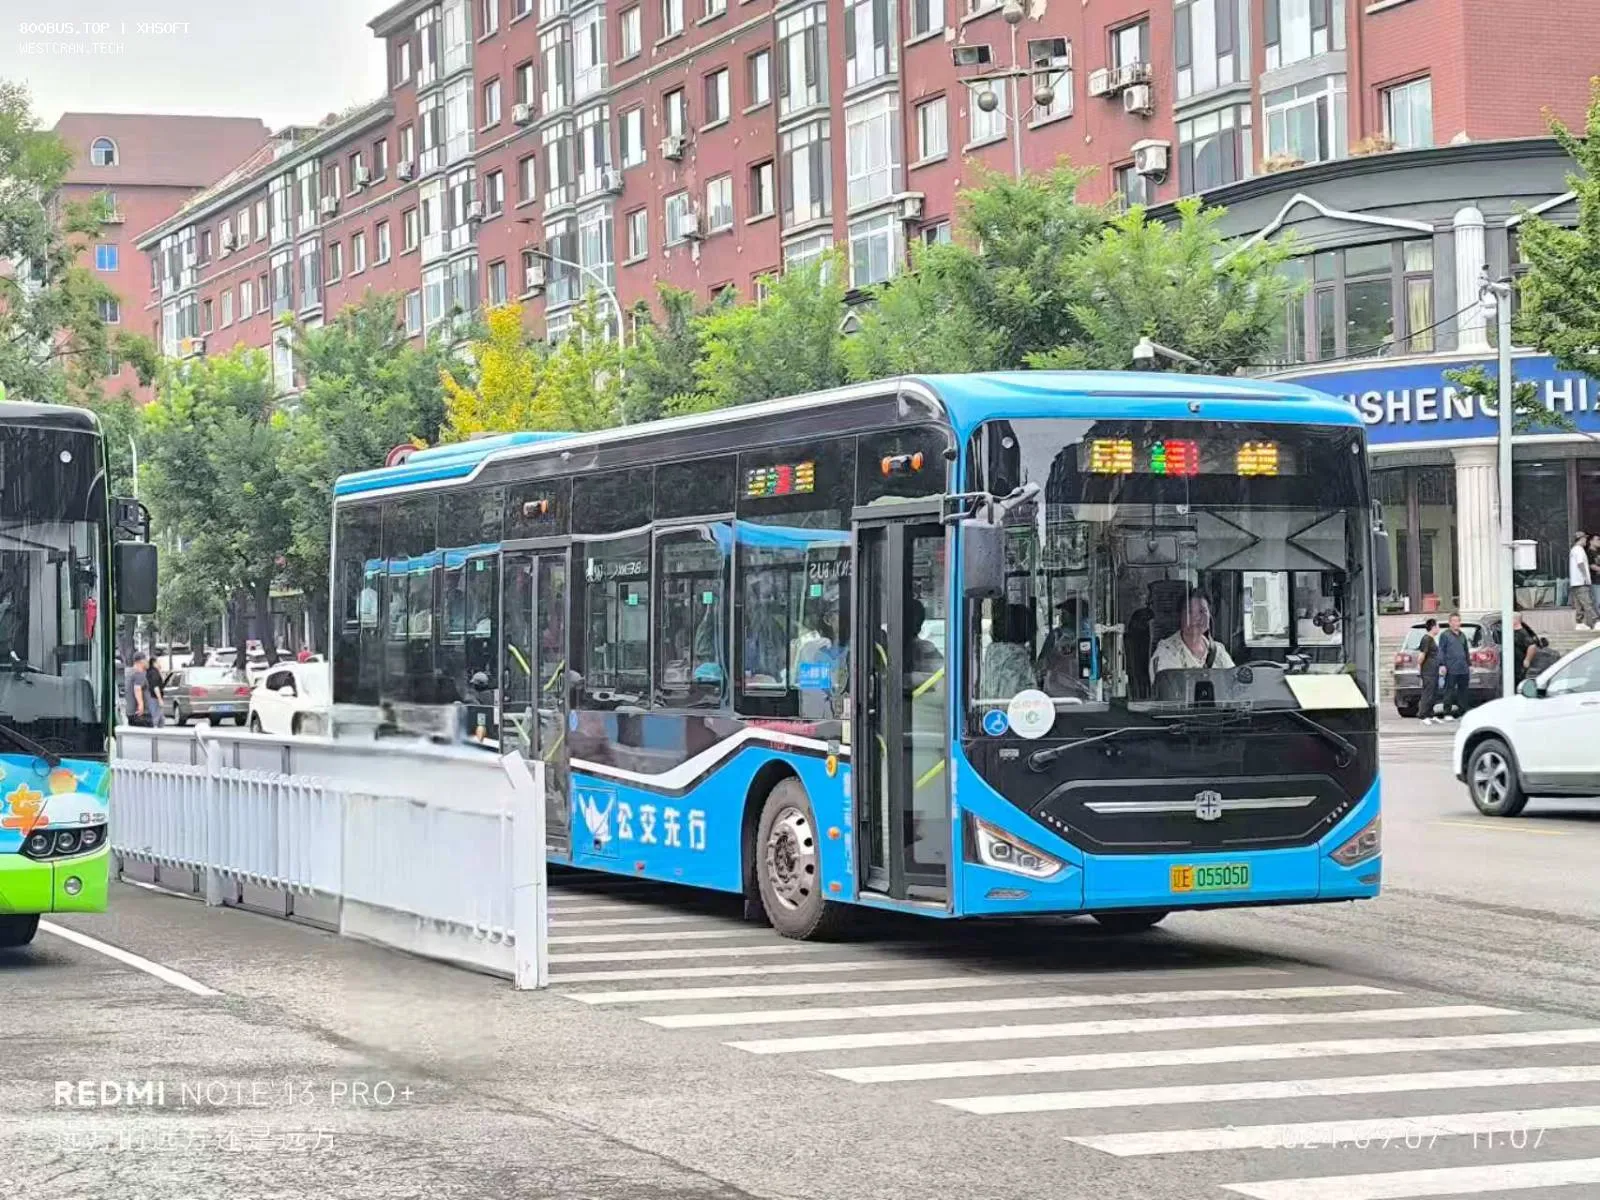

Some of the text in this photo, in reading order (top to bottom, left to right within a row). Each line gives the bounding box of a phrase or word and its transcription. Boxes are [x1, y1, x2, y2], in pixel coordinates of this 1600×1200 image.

[1342, 377, 1600, 425] SHENHI
[616, 801, 707, 851] 公交先行
